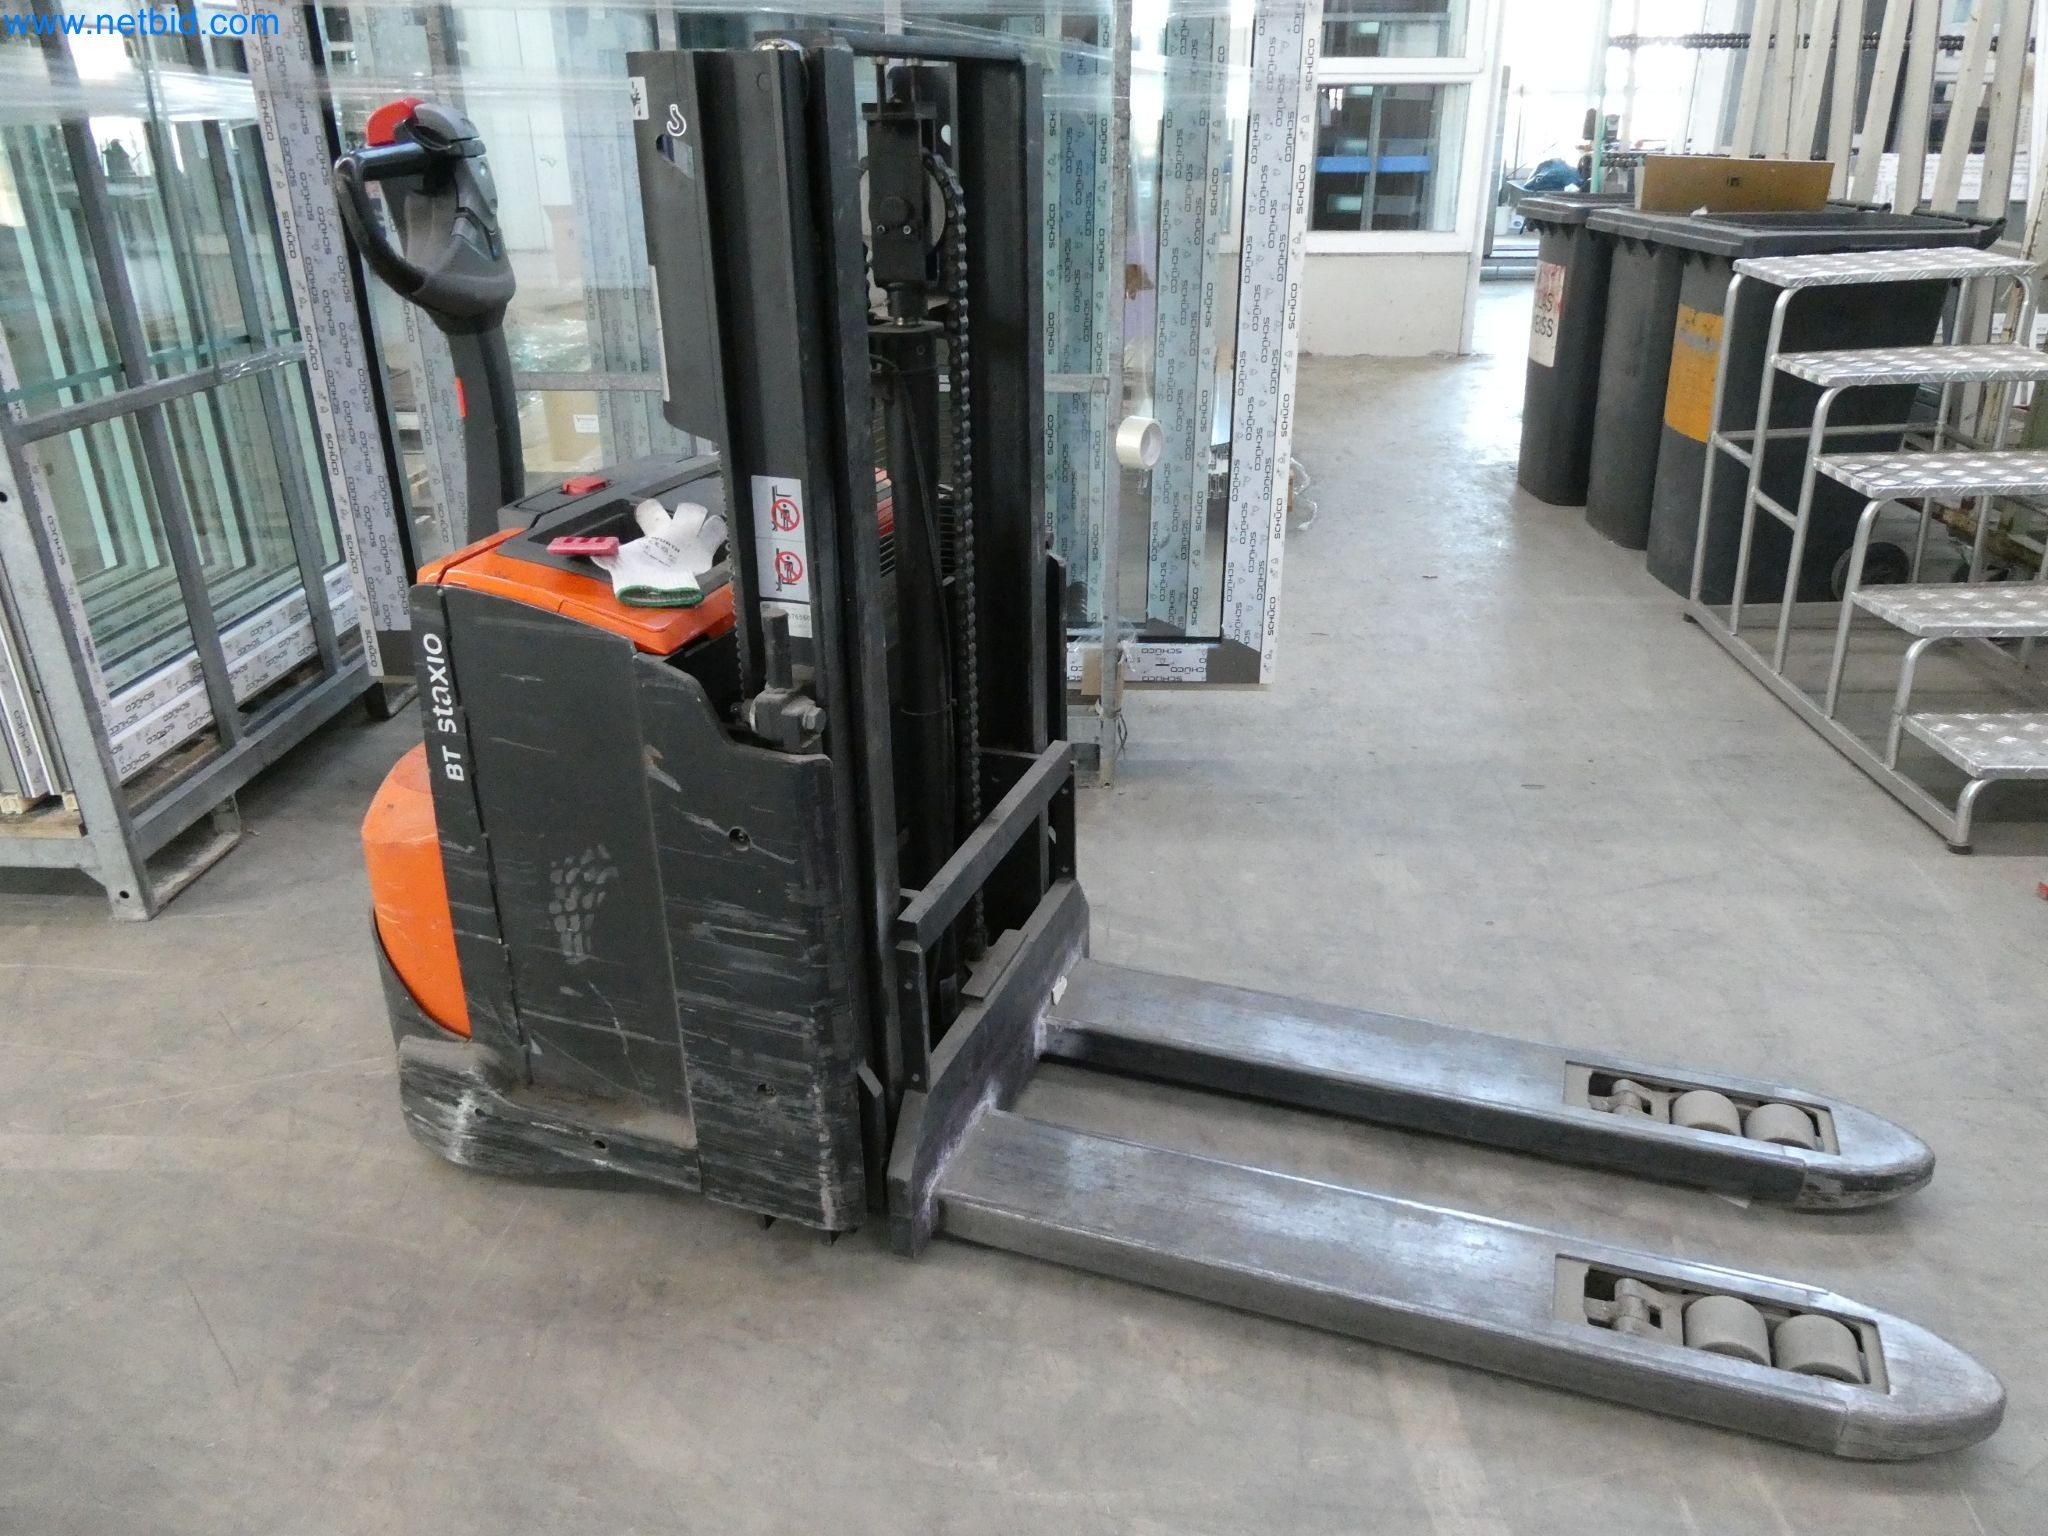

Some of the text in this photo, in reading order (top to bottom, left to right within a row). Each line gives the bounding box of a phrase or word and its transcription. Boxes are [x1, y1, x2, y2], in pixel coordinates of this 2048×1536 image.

[1305, 38, 1315, 91] SCHÜCO
[1251, 113, 1261, 165] SCHÜCO
[1209, 167, 1219, 216] SCHÜCO
[1296, 164, 1306, 215] SCHÜCO
[1244, 235, 1253, 284] SCHÜCO
[1204, 282, 1213, 328] SCHÜCO
[1288, 283, 1298, 330] SCHÜCO
[1238, 350, 1247, 397] SCHÜCO
[1200, 390, 1208, 432] SCHÜCO
[1280, 393, 1290, 438] SCHÜCO
[1232, 459, 1241, 502] SCHÜCO
[1195, 490, 1204, 532] SCHÜCO
[1273, 498, 1283, 539] SCHÜCO
[1227, 562, 1236, 603] SCHÜCO
[1190, 587, 1199, 626] SCHÜCO
[1267, 597, 1276, 636] SCHÜCO
[442, 745, 465, 782] BT
